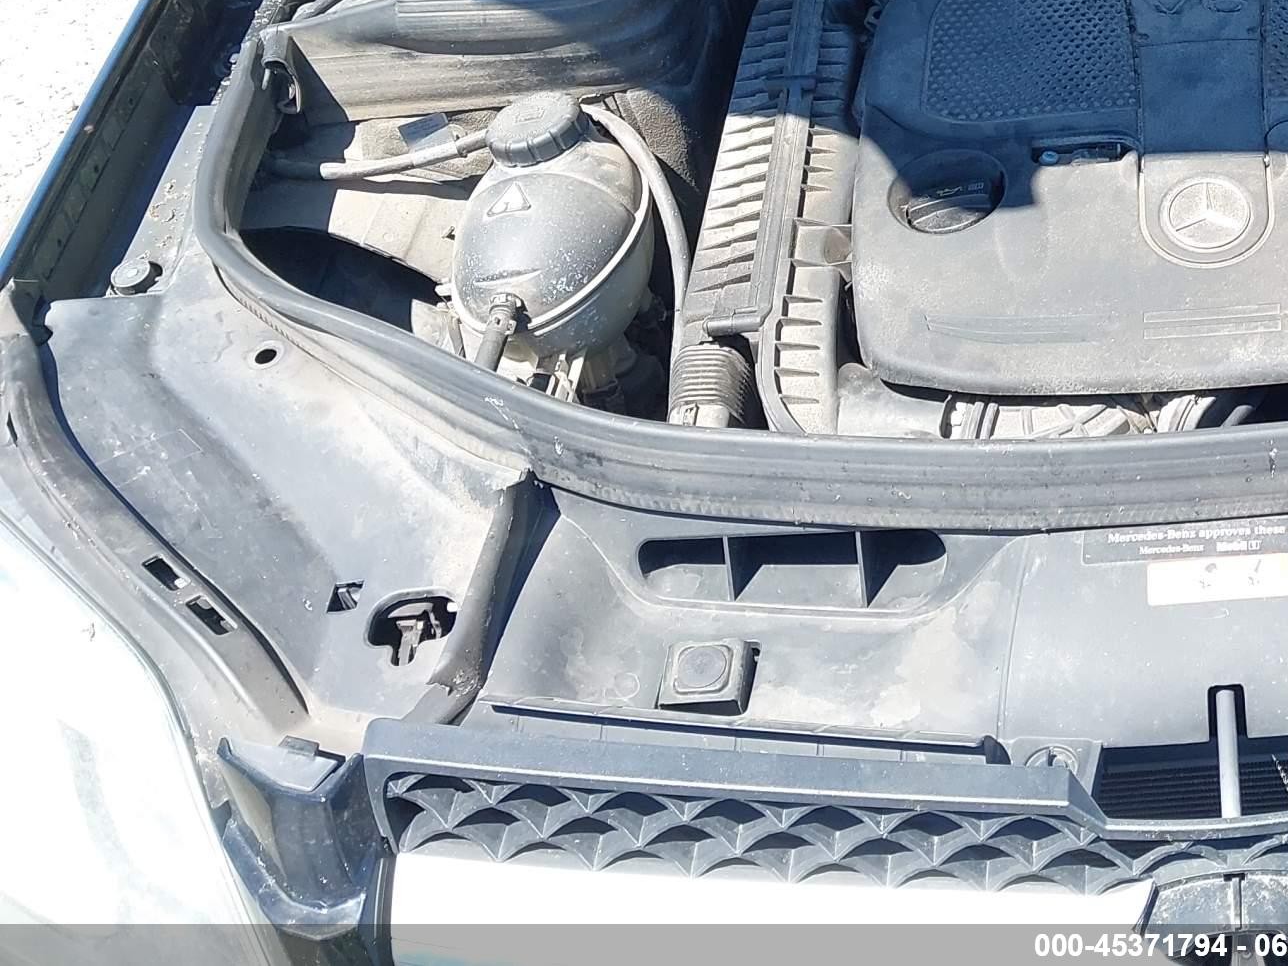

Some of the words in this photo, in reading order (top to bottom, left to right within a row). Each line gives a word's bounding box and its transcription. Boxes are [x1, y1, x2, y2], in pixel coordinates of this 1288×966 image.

[1107, 528, 1196, 544] Mercedes-Benz
[1198, 526, 1251, 541] approves
[1254, 524, 1286, 536] these
[1139, 543, 1204, 555] Mercedes-Benz
